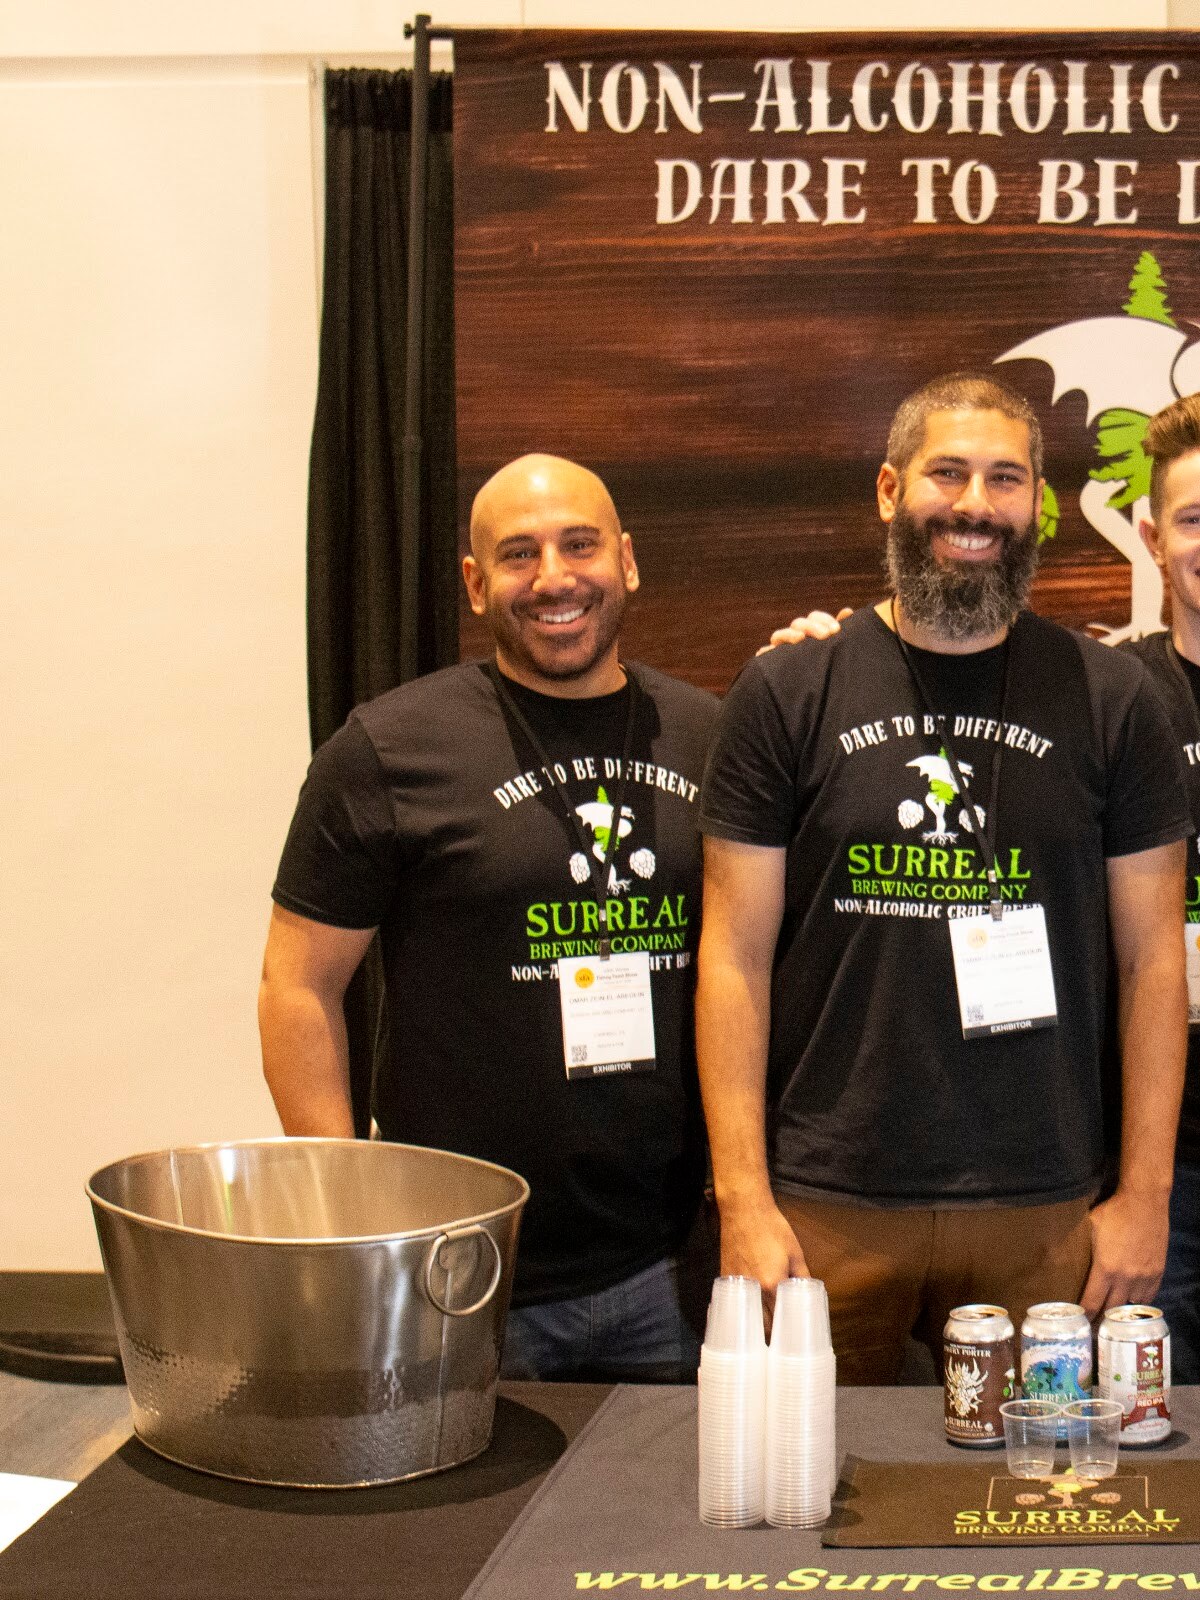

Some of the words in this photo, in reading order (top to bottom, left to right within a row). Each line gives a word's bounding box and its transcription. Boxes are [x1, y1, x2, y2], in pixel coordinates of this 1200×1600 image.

[544, 58, 1181, 137] NON-ALCOHOLIC
[655, 157, 867, 226] DARE
[901, 158, 1001, 225] TO
[1038, 158, 1140, 226] BE
[839, 721, 888, 756] DARE
[892, 715, 915, 737] TO
[493, 770, 546, 810] DARE
[572, 757, 598, 781] BE
[852, 878, 928, 899] BREWING
[931, 883, 1028, 900] COMPNY
[526, 895, 689, 938] SURREAL
[834, 898, 942, 919] NON-ALCOHOLIC
[990, 1020, 1032, 1034] EXHIBITOR
[592, 1061, 632, 1074] EXHIBITOR
[1029, 1391, 1073, 1403] SURREAL
[953, 1508, 1180, 1525] SURREAL
[954, 1524, 1056, 1536] BREWING
[1061, 1523, 1180, 1534] COMPANY
